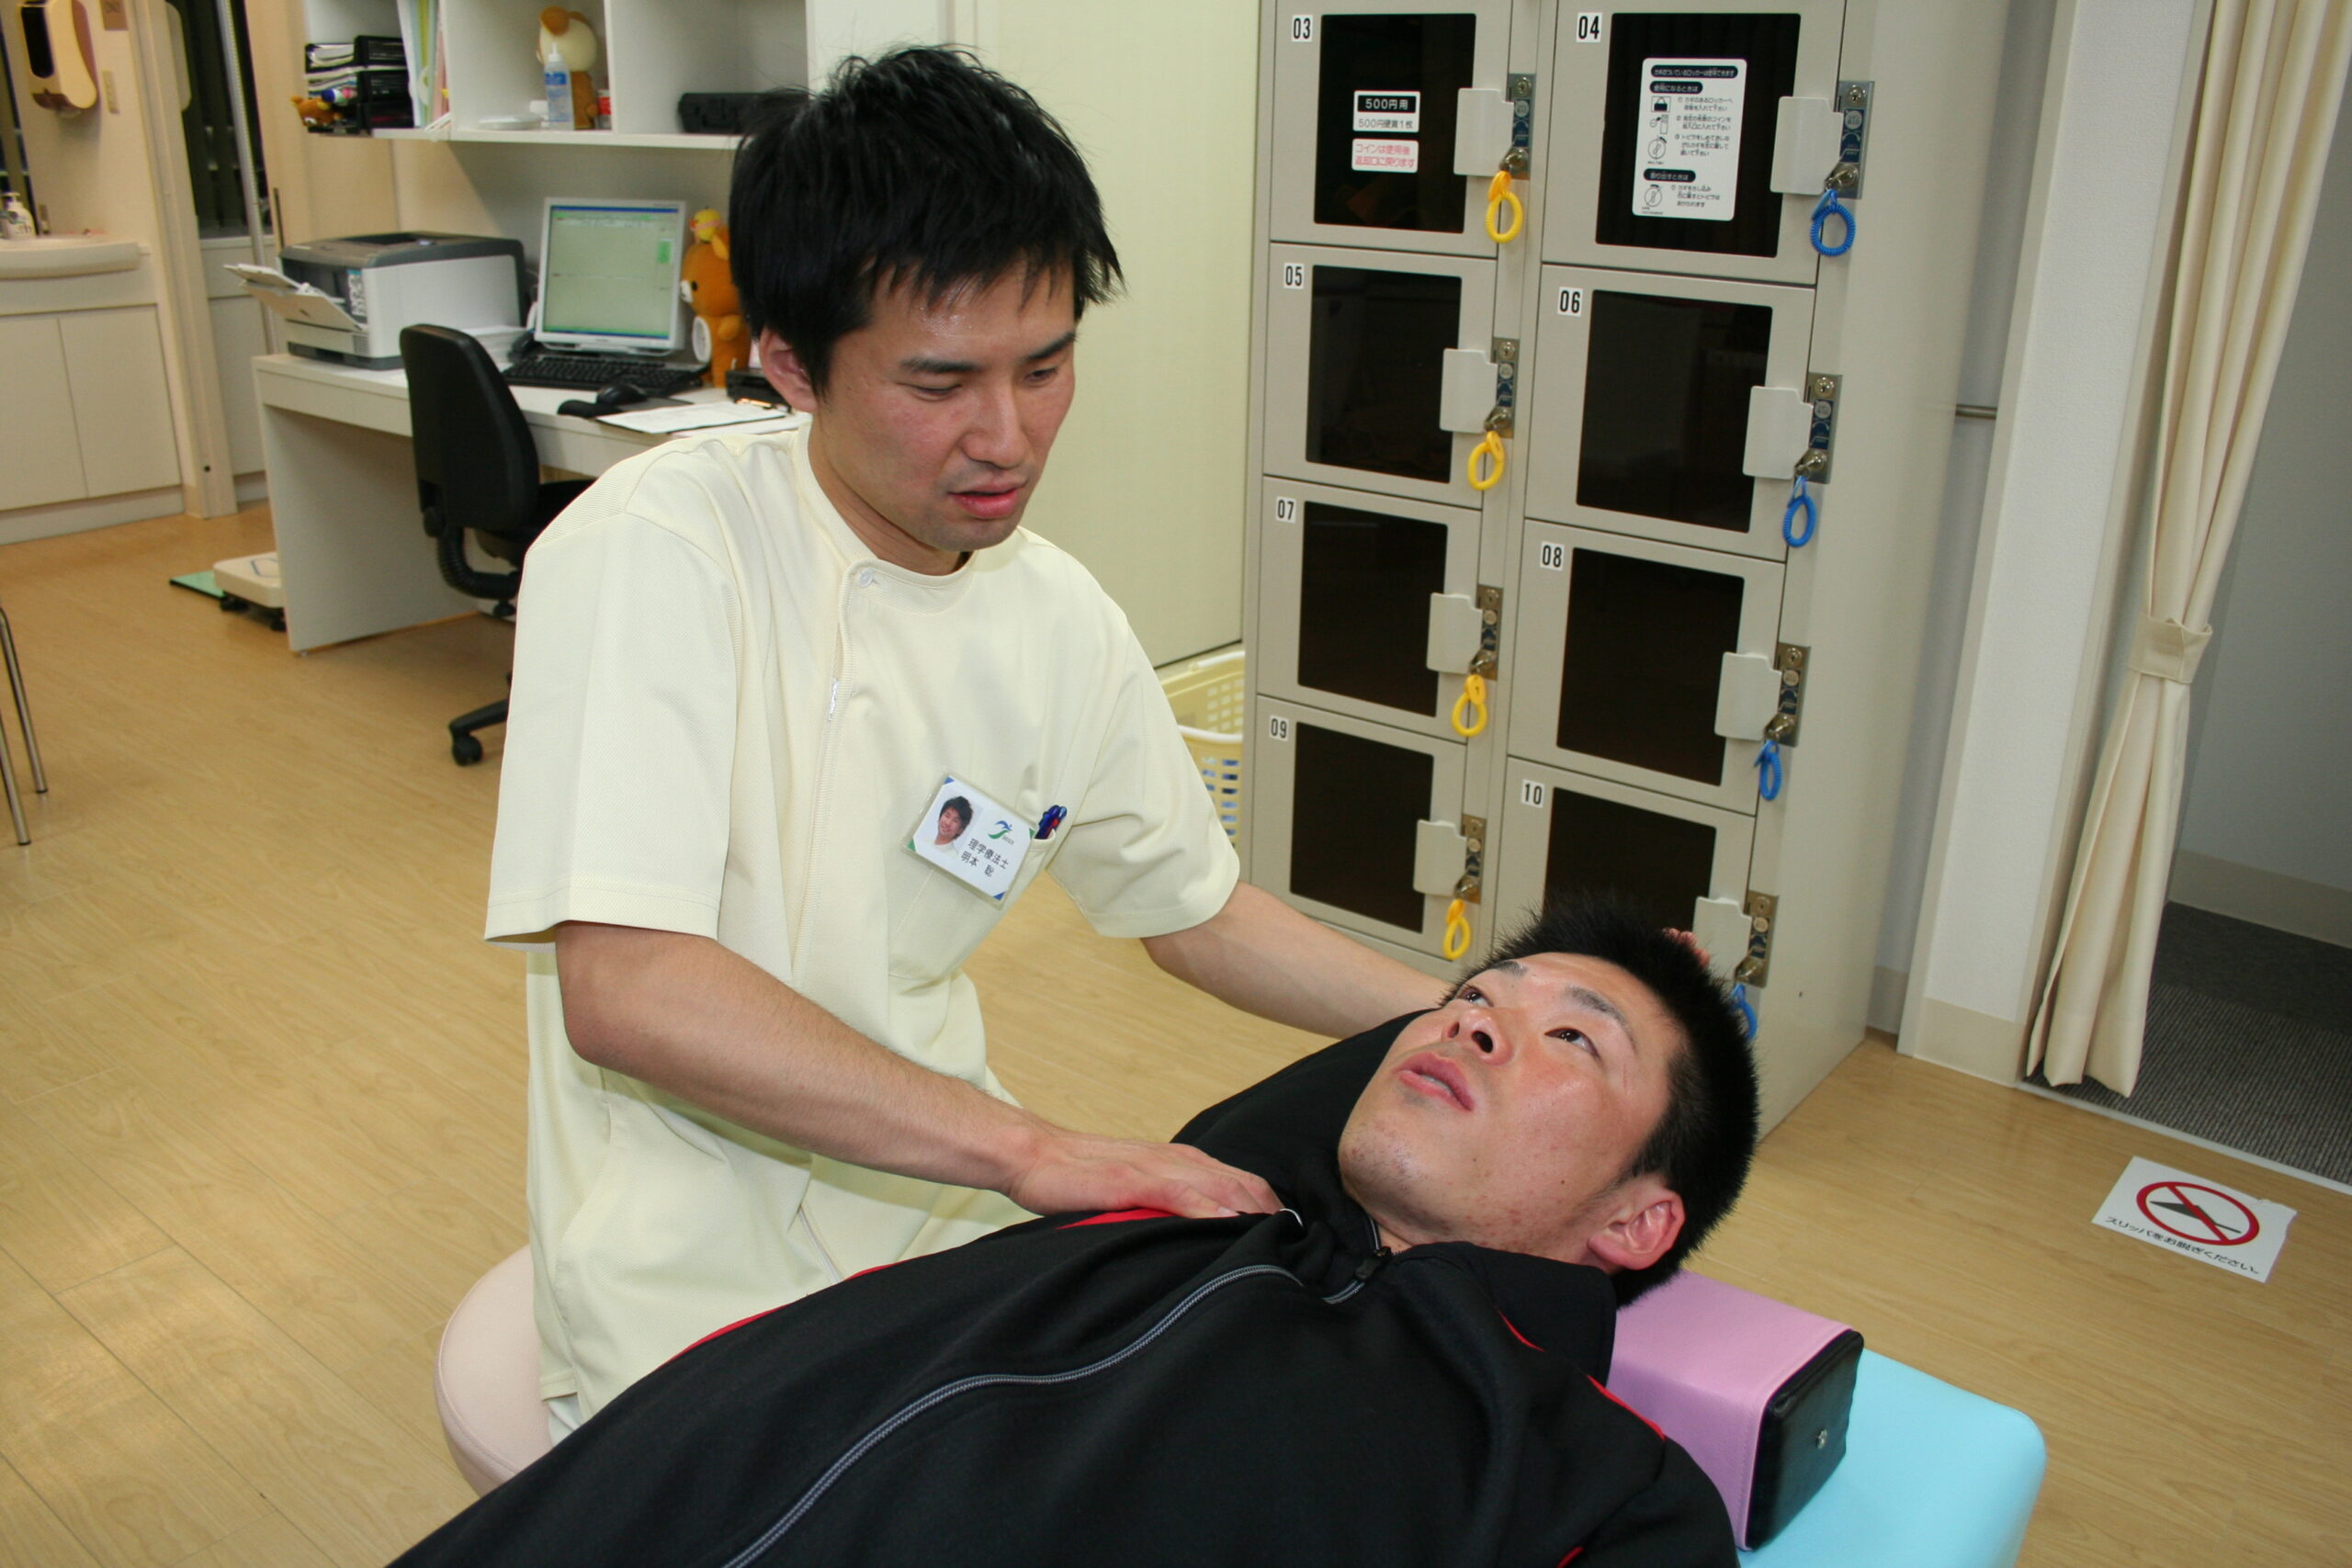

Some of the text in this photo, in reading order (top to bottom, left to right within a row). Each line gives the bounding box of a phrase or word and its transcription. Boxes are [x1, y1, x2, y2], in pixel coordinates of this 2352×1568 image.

[1294, 18, 1310, 39] 03
[1578, 16, 1600, 39] 04
[1286, 265, 1302, 286] 05
[1560, 290, 1580, 313] 06
[1278, 500, 1294, 520] 07
[1543, 546, 1562, 568] 08
[1272, 718, 1286, 739] 09
[1526, 784, 1542, 805] 10
[967, 838, 1009, 870] 理学療法士
[2105, 1215, 2260, 1275] スリッパをお脱ぎください
